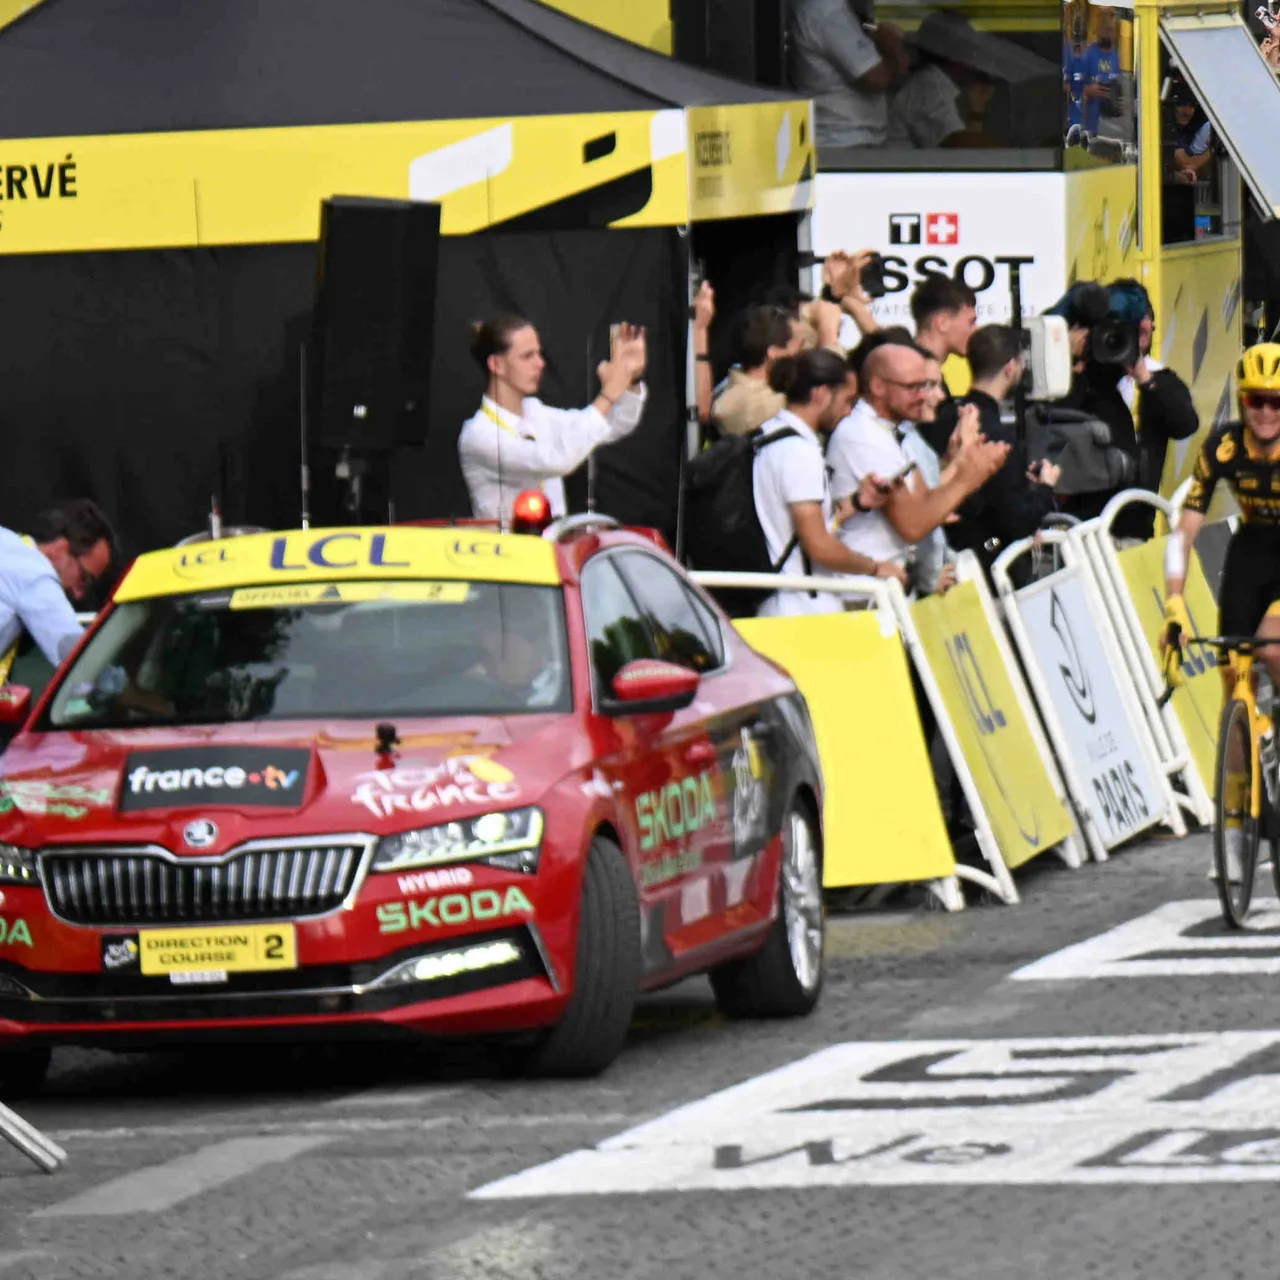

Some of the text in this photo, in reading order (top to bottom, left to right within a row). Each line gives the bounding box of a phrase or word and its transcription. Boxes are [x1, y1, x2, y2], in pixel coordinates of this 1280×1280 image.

[0, 152, 78, 201] RVÉ
[181, 548, 234, 568] LCL
[270, 533, 410, 571] LCL
[454, 540, 511, 558] LCL
[350, 781, 522, 819] france
[635, 772, 717, 851] SKODA
[1091, 759, 1150, 837] PARIS
[398, 867, 475, 895] HYBRID
[376, 885, 535, 934] SKODA
[146, 933, 285, 960] DIRECTION 2
[159, 951, 237, 965] COURSE
[712, 1133, 1015, 1170] We
